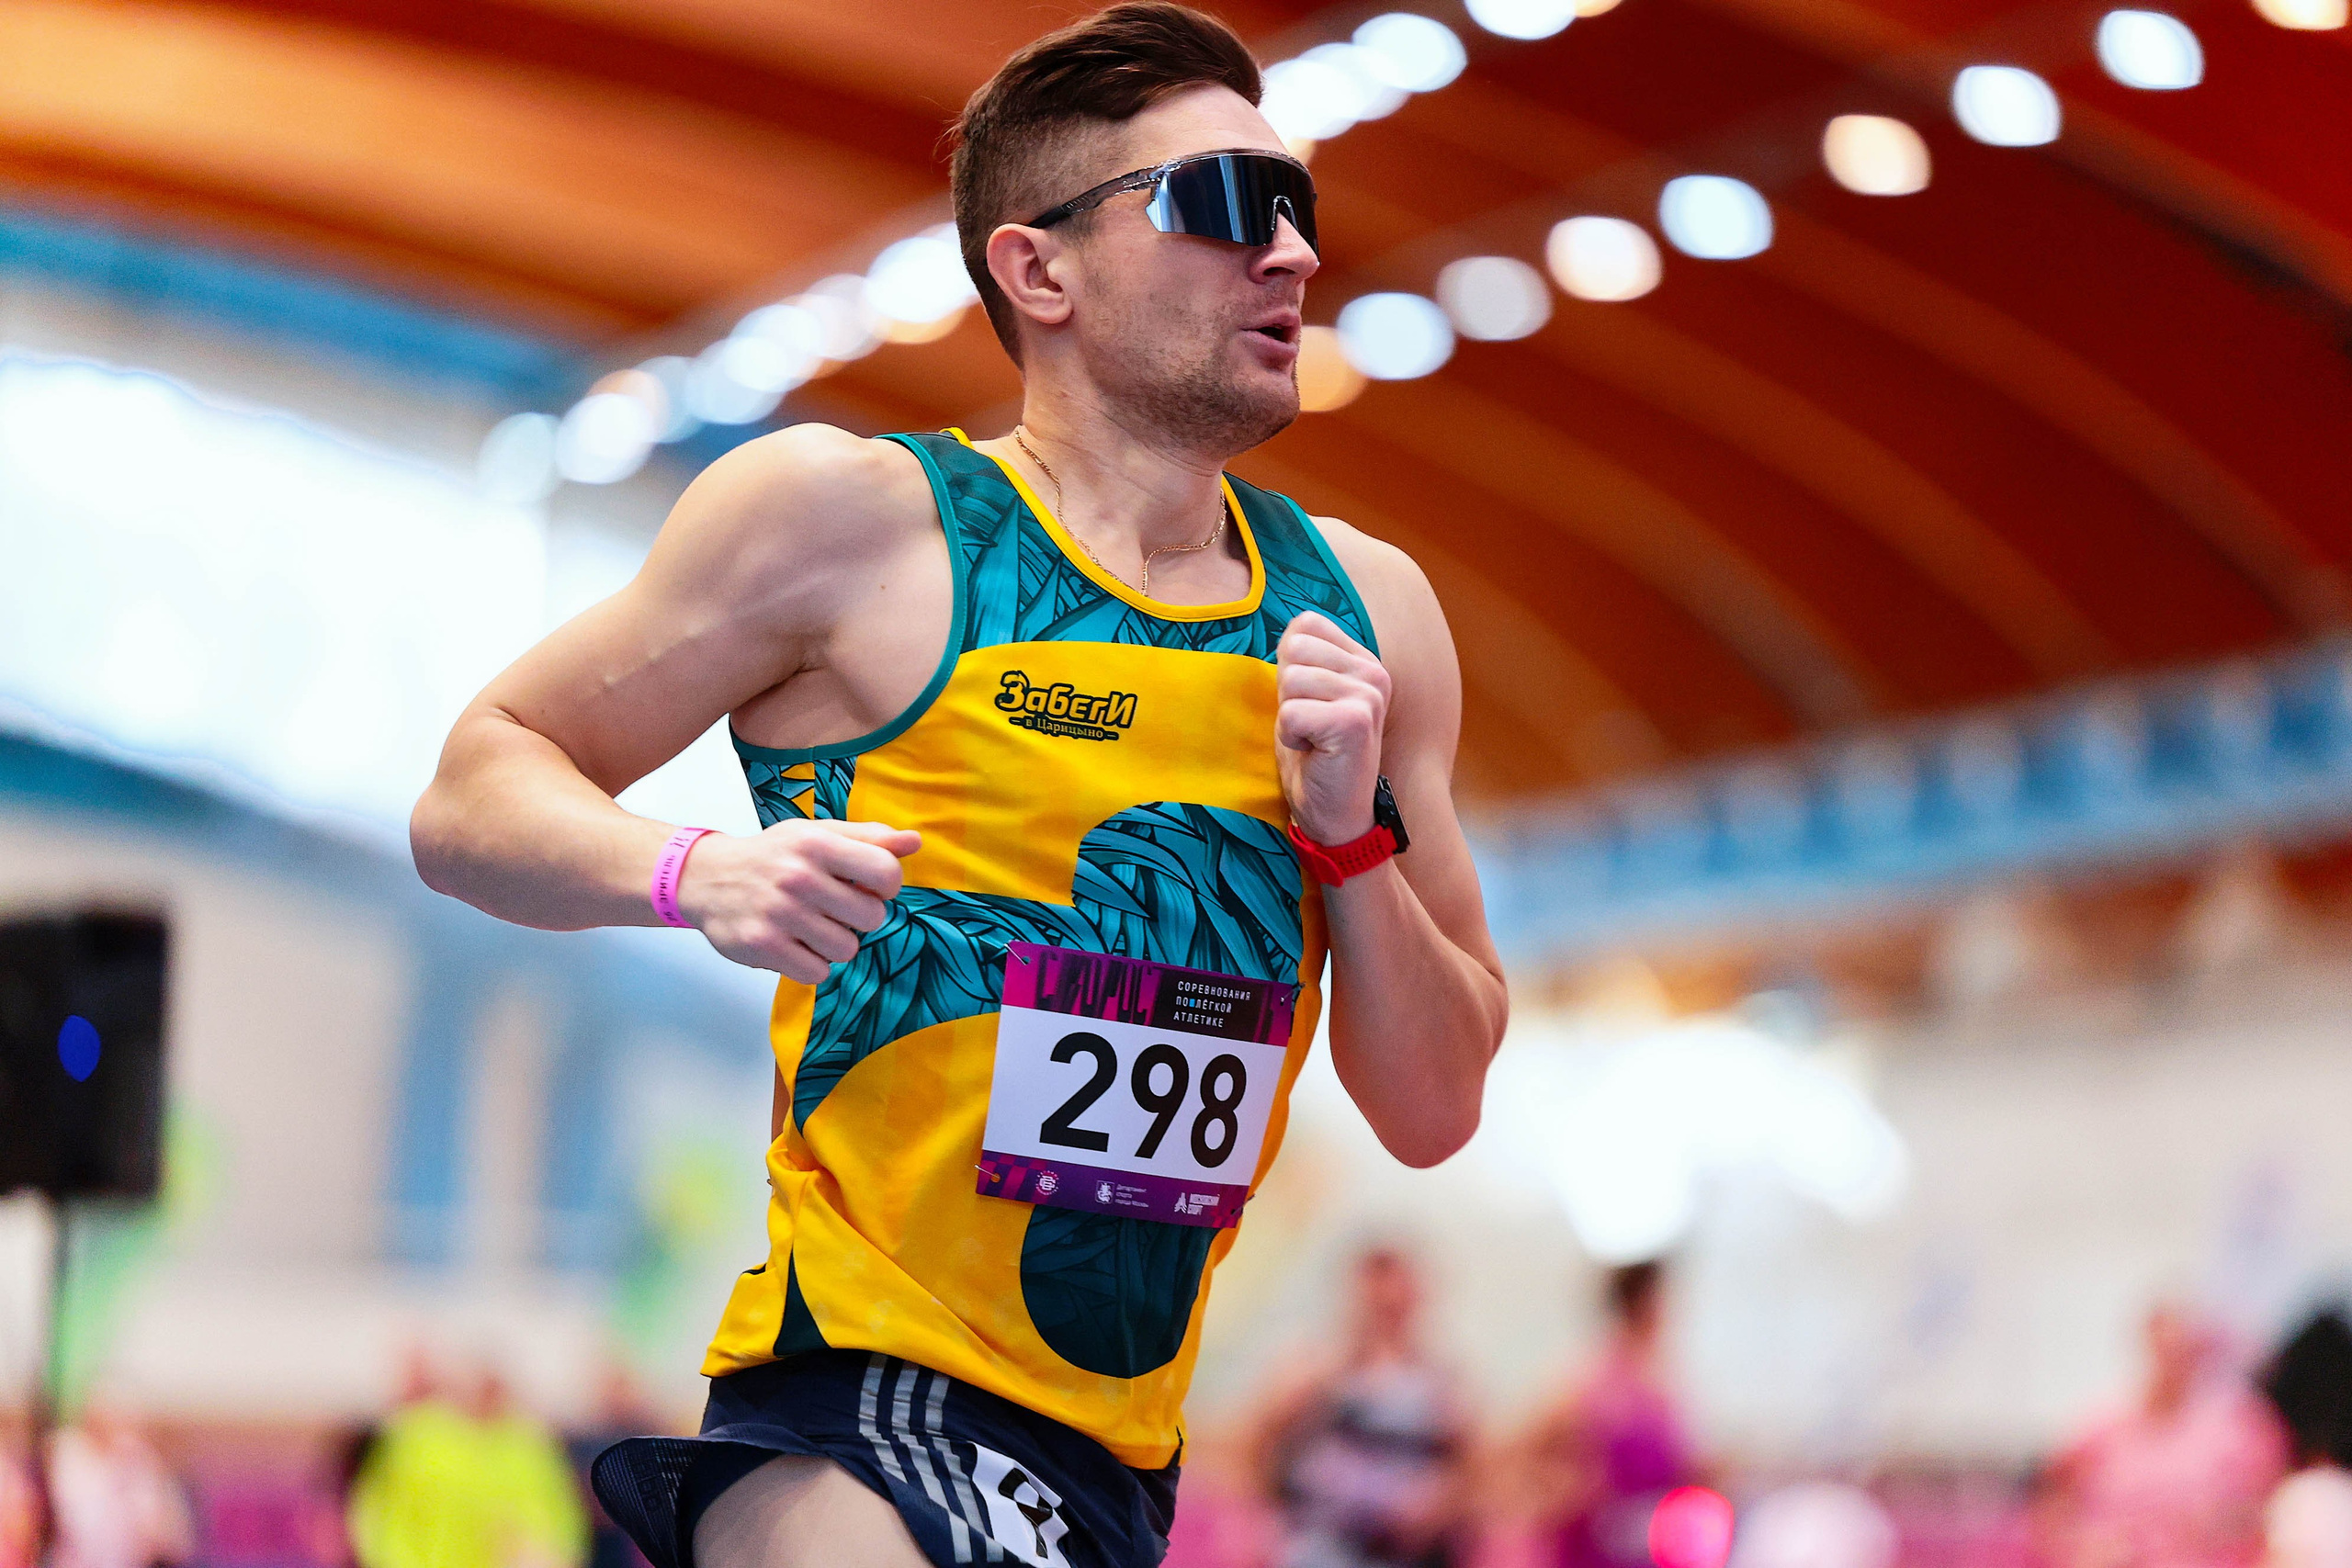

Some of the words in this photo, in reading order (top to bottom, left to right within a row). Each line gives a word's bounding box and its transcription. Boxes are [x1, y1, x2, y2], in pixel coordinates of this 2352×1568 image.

[1025, 718, 1033, 727] в
[1036, 718, 1103, 738] Царицыно
[1177, 980, 1251, 1001] СОРЕВНОВАНИЯ
[1176, 996, 1189, 1007] ПО
[1173, 1011, 1225, 1028] АТЛЕТИКЕ
[1039, 1032, 1247, 1168] 298
